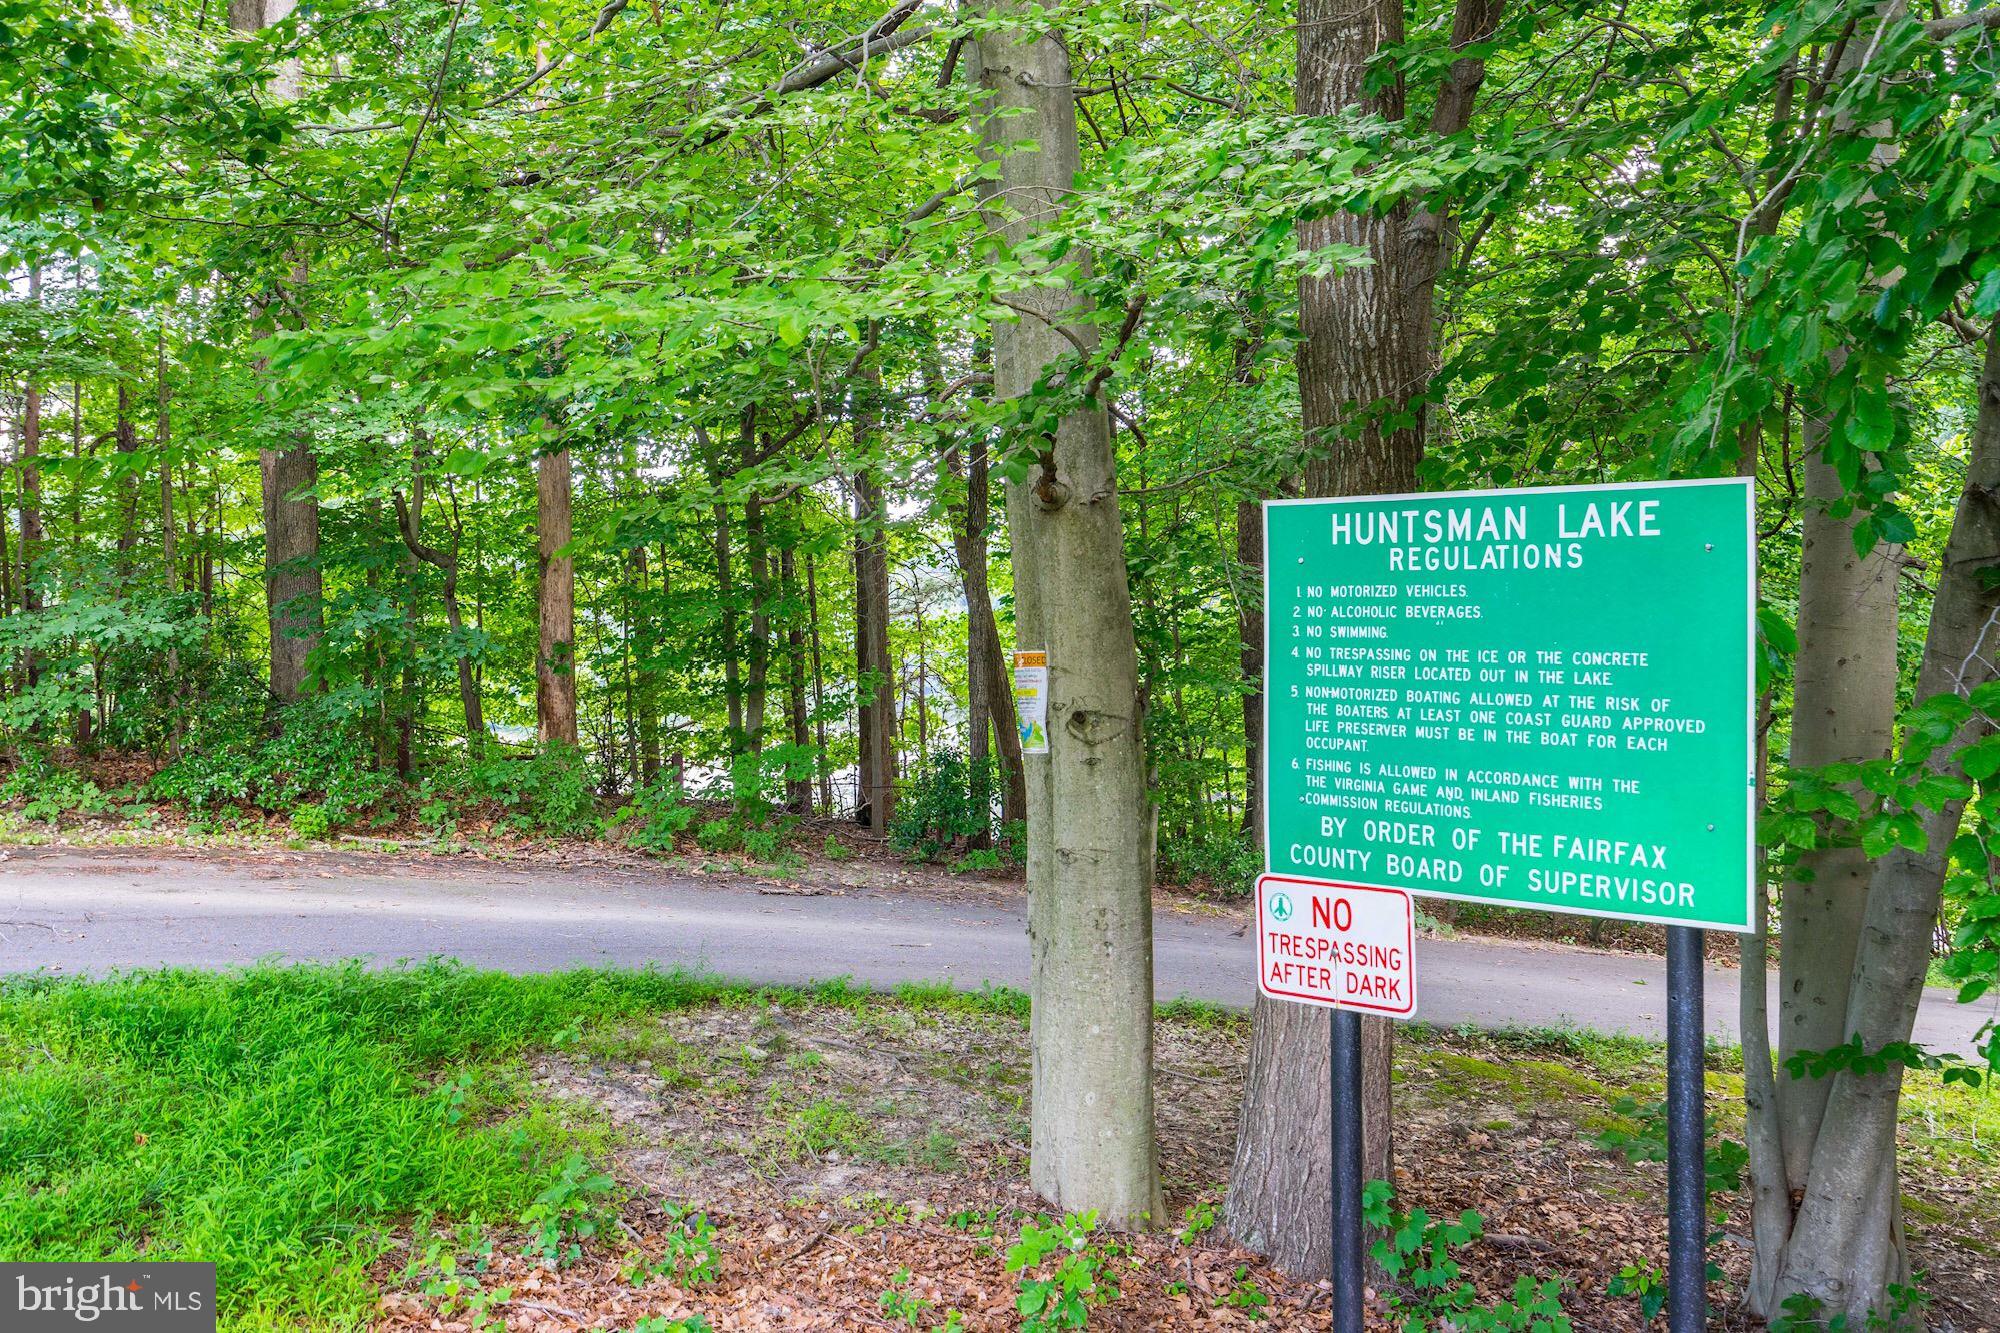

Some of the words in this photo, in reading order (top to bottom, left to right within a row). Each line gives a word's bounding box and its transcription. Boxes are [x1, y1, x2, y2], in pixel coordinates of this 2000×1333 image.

[1332, 506, 1526, 545] HUNTSMAN
[1559, 500, 1660, 538] LAKE
[1390, 543, 1583, 571] REGULATIONS
[1307, 586, 1322, 598] NO
[1331, 585, 1397, 597] MOTORIZED
[1406, 585, 1468, 597] VEHICLES.
[1308, 606, 1323, 618] NO
[1331, 606, 1397, 618] ALCOHOLIC
[1406, 605, 1482, 618] BEVERAGES.
[1307, 626, 1322, 637] NO
[1306, 647, 1321, 658] NO
[1330, 647, 1411, 661] TRESPASSING
[1420, 649, 1436, 661] ON
[1446, 649, 1469, 662] THE
[1478, 650, 1498, 663] ICE
[1508, 650, 1526, 663] OR
[1536, 651, 1562, 664] THE
[1573, 652, 1648, 666] CONCRETE
[1307, 663, 1363, 677] SPILLWAY
[1371, 665, 1405, 679] RISER
[1415, 667, 1471, 681] LOCATED
[1480, 669, 1505, 682] OUT
[1515, 670, 1528, 683] IN
[1538, 670, 1564, 684] THE
[1306, 686, 1398, 701] NON-MOTORIZED
[1406, 690, 1460, 704] BOATING
[1470, 692, 1532, 707] ALLOWED
[1543, 695, 1559, 707] AT
[1569, 696, 1595, 709] THE
[1606, 696, 1639, 711] RISK
[1651, 699, 1670, 712] OF
[1307, 703, 1327, 715] THE
[1397, 707, 1411, 719] AT
[1421, 708, 1460, 722] LEAST
[1470, 710, 1496, 724] ONE
[1506, 712, 1551, 726] COAST
[1562, 714, 1611, 729] GUARD
[1622, 717, 1705, 733] APPROVED
[1305, 720, 1329, 732] LIFE
[1337, 722, 1406, 737] PRESERVER
[1415, 726, 1449, 739] MUST
[1458, 728, 1474, 741] BE
[1484, 729, 1496, 742] IN
[1506, 730, 1531, 744] THE
[1541, 732, 1578, 746] BOAT
[1587, 734, 1616, 748] FOR
[1627, 736, 1667, 751] EACH
[1306, 737, 1369, 751] OCCUPANT.
[1306, 758, 1351, 773] FISHING
[1360, 762, 1371, 775] IS
[1379, 764, 1436, 779] ALLOWED
[1445, 768, 1457, 780] IN
[1467, 770, 1558, 788] ACCORDANCE
[1569, 777, 1602, 791] WITH
[1613, 779, 1639, 794] THE
[1305, 793, 1377, 810] COMMISSION
[1306, 775, 1326, 788] THE
[1335, 778, 1385, 792] VIRGINIA
[1393, 782, 1427, 796] GAME
[1436, 786, 1463, 801] AND
[1471, 788, 1519, 803] INLAND
[1529, 792, 1602, 810] FISHERIES
[1321, 816, 1347, 837] BY
[1364, 820, 1435, 847] ORDER
[1452, 828, 1481, 850] OF
[1498, 832, 1542, 857] THE
[1554, 835, 1666, 869] FAIRFAX
[1290, 844, 1371, 871] COUNTY
[1387, 854, 1462, 882] BOARD
[1480, 864, 1509, 887] OF
[1528, 869, 1694, 907] SUPERVISOR
[1312, 896, 1352, 931] NO
[1269, 932, 1401, 971] TRESPASSING
[1270, 962, 1331, 990] AFTER
[1347, 972, 1401, 1001] DARK
